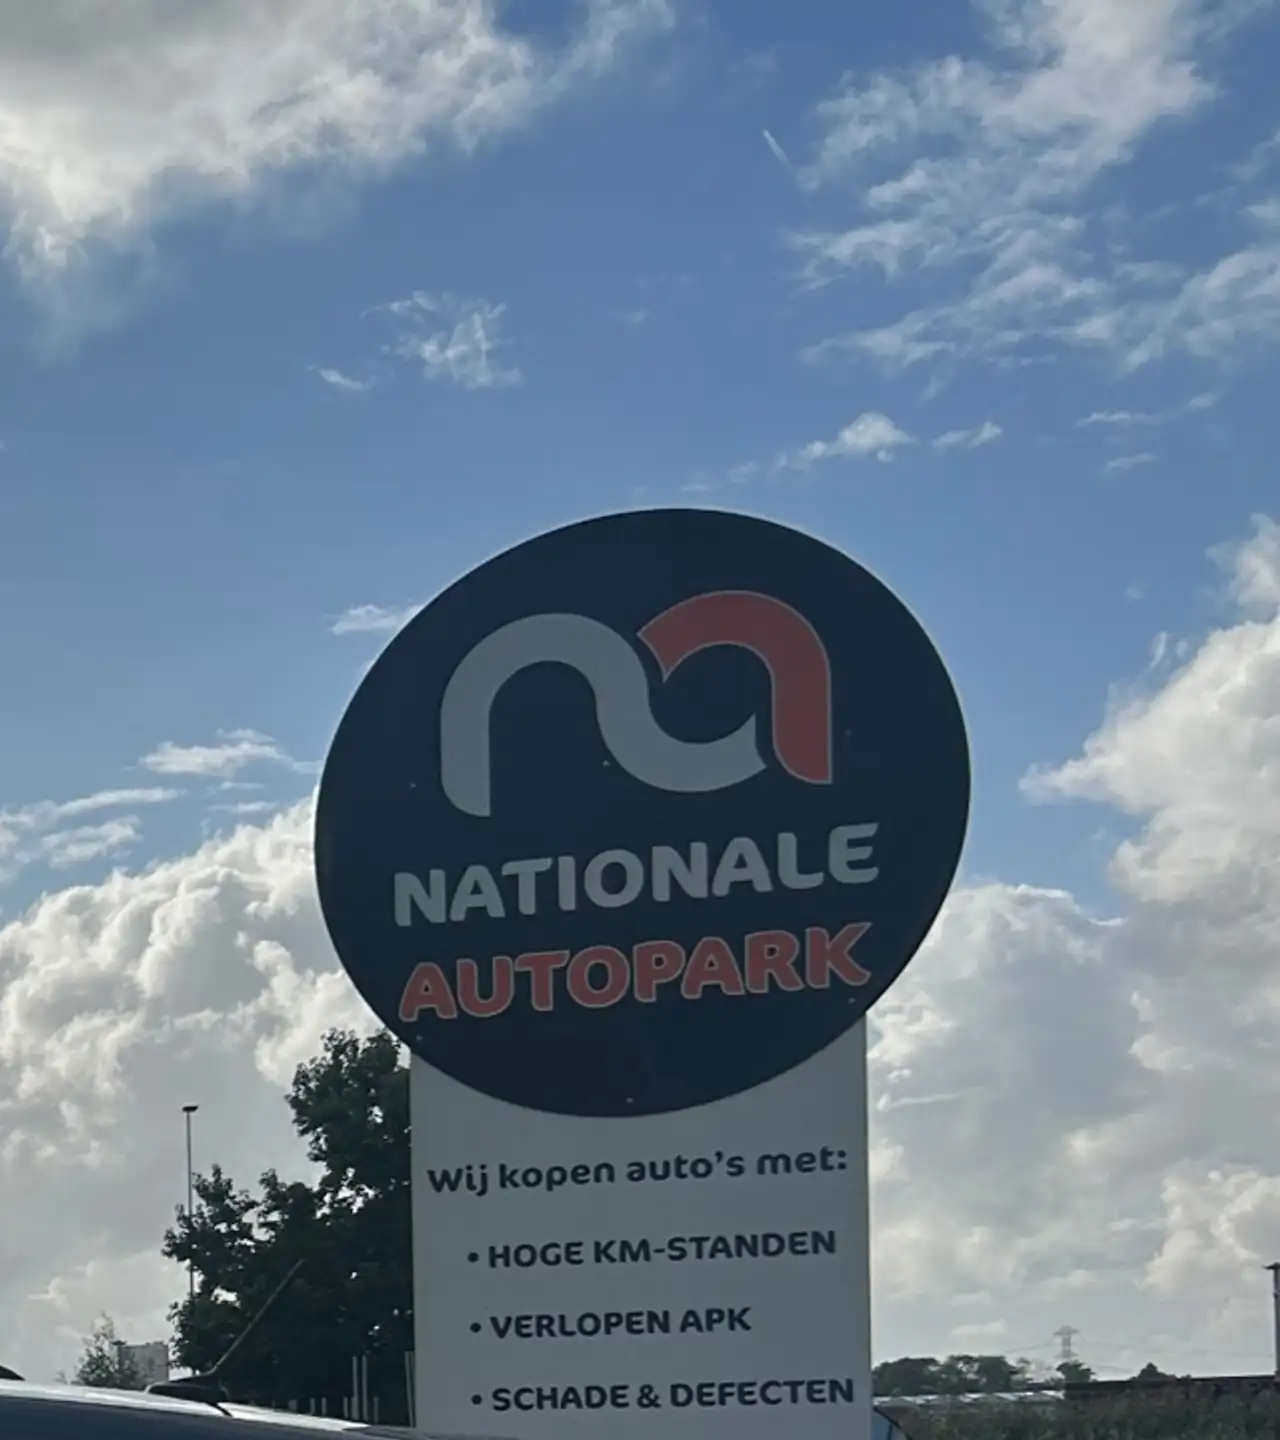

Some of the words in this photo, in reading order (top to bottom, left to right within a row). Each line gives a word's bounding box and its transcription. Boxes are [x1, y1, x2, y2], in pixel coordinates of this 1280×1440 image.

[394, 823, 879, 926] NATIONALE
[398, 922, 873, 1022] AUTOPARK
[427, 1164, 489, 1197] Wij
[499, 1159, 615, 1191] kopen
[626, 1151, 745, 1183] auto's
[756, 1146, 847, 1176] met:
[488, 1241, 583, 1268] HOGE
[594, 1230, 836, 1265] KM-STANDEN
[490, 1310, 670, 1339] VERLOPEN
[679, 1307, 752, 1334] APK
[491, 1384, 629, 1412] SCHADE
[636, 1384, 661, 1409] &
[671, 1379, 854, 1408] DEFECTEN
